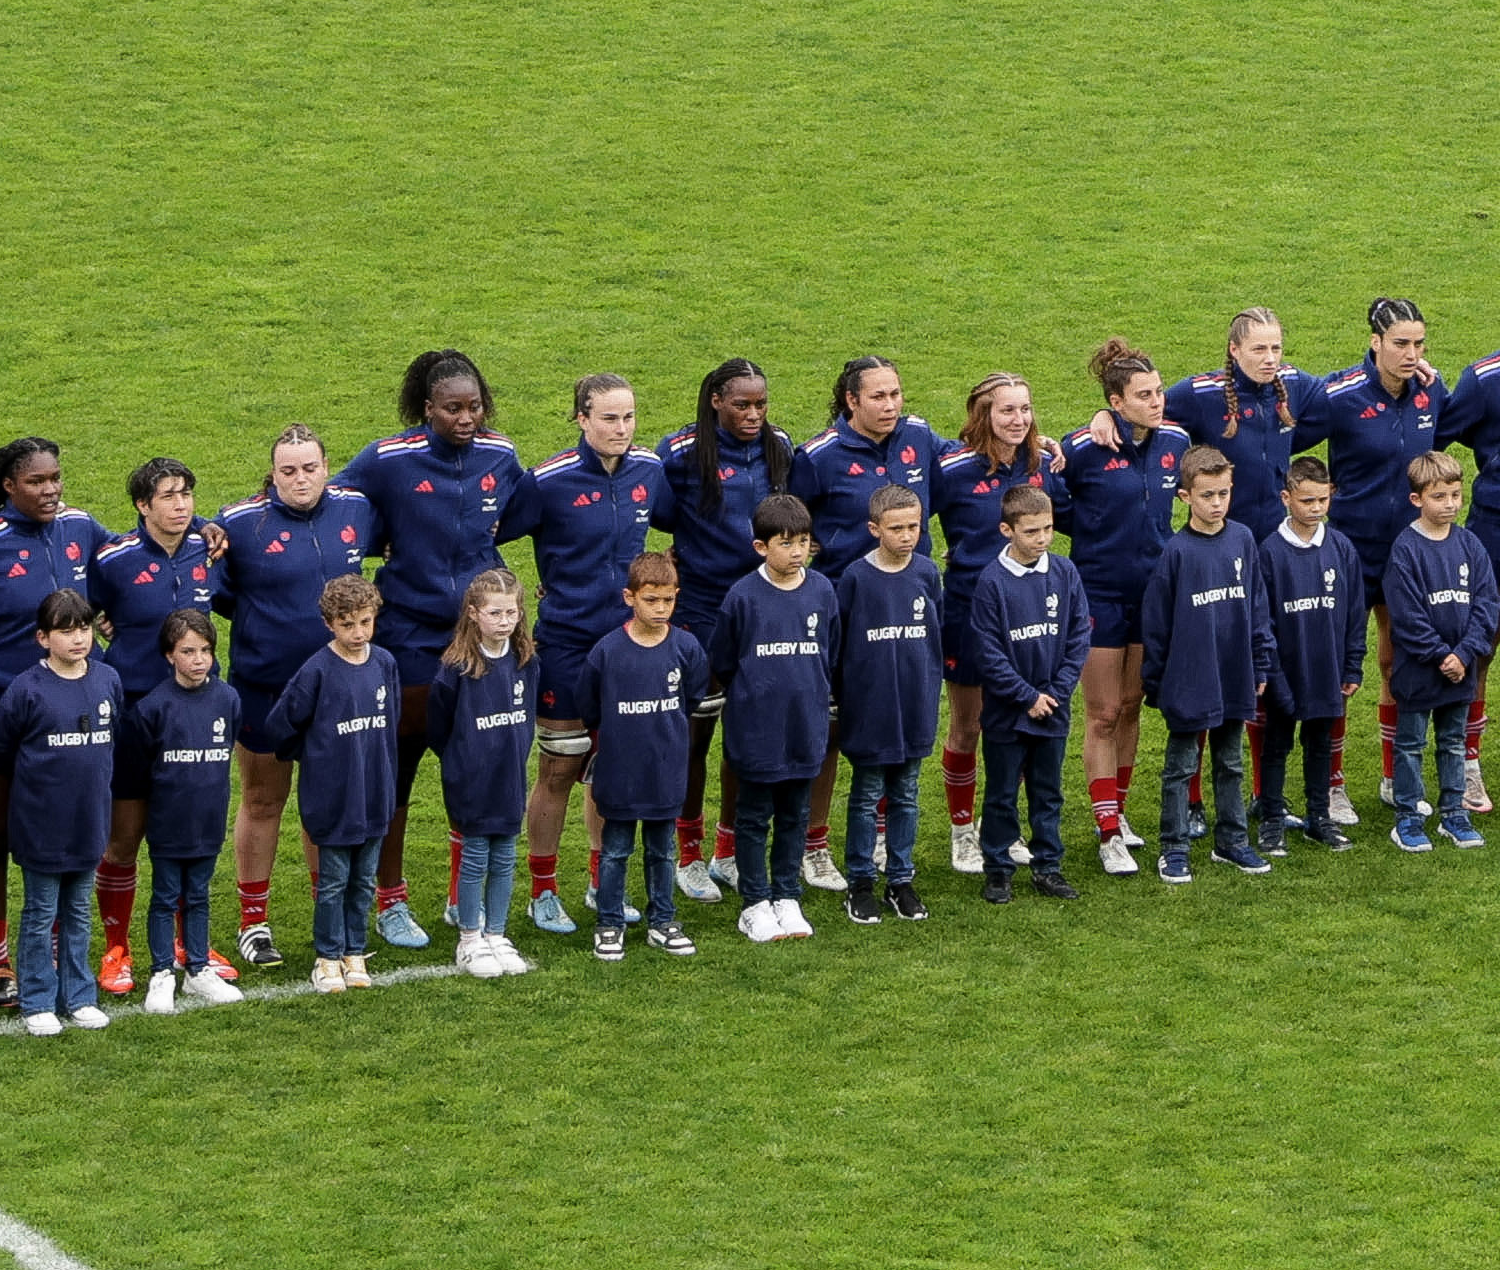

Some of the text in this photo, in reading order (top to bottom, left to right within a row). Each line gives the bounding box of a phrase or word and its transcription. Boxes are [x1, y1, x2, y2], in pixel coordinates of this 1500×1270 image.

[1192, 587, 1228, 607] RUGBY
[1429, 589, 1455, 604] UGBY
[1284, 597, 1320, 613] RUGBY
[1010, 624, 1047, 641] RUGBY
[757, 642, 819, 656] RUGBY KID
[619, 700, 660, 714] RUGBY
[476, 712, 514, 730] RUGBY
[48, 733, 89, 746] RUGBY
[164, 749, 229, 762] RUGBY KIDS
